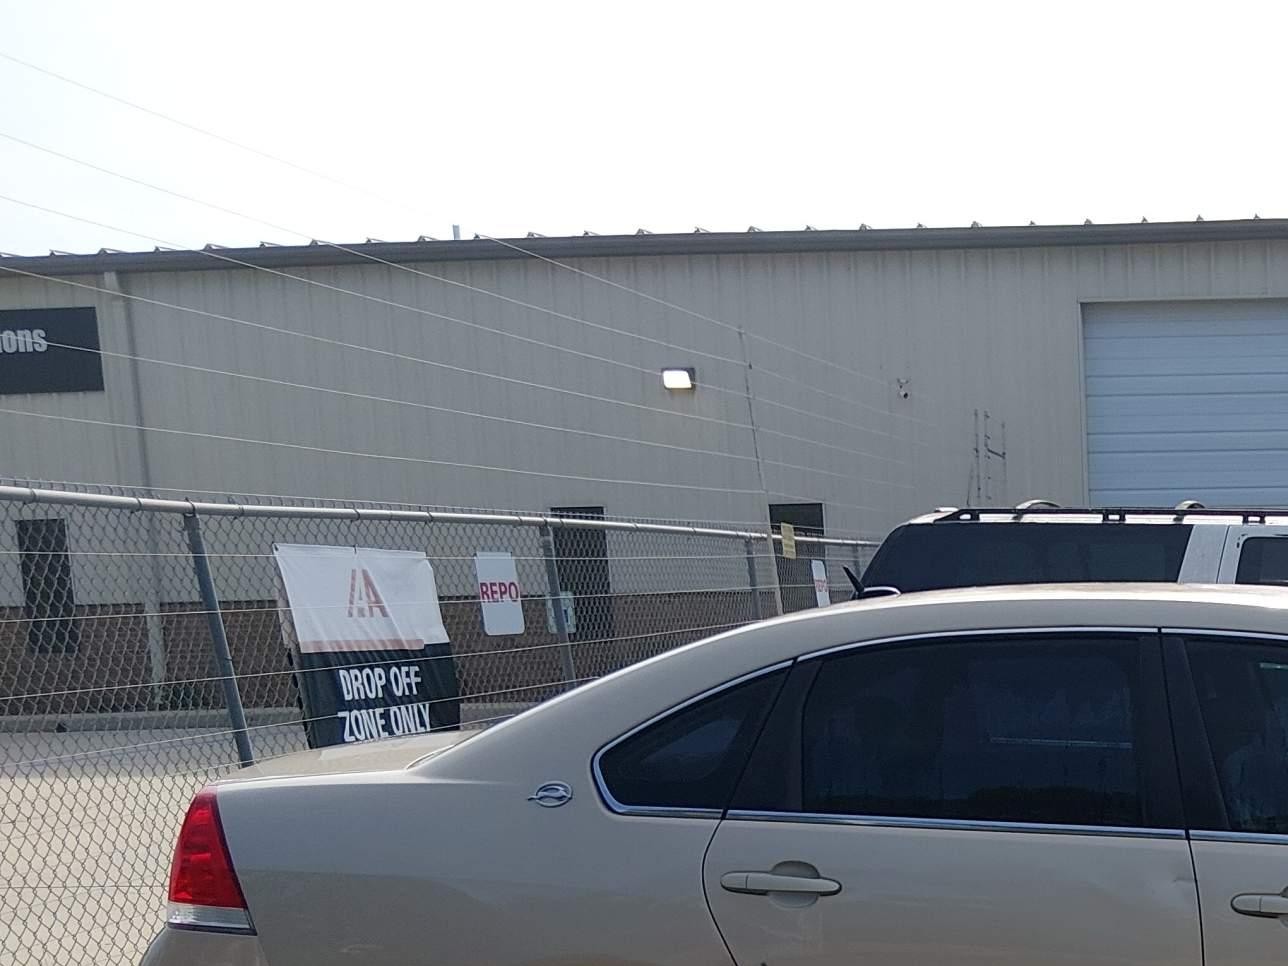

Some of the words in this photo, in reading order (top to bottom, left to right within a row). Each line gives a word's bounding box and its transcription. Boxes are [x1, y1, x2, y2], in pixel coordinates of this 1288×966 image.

[479, 581, 519, 603] REPO
[339, 667, 386, 701] DROP
[389, 665, 422, 697] OFF
[337, 709, 389, 742] ZONE
[390, 703, 430, 735] ONLY
